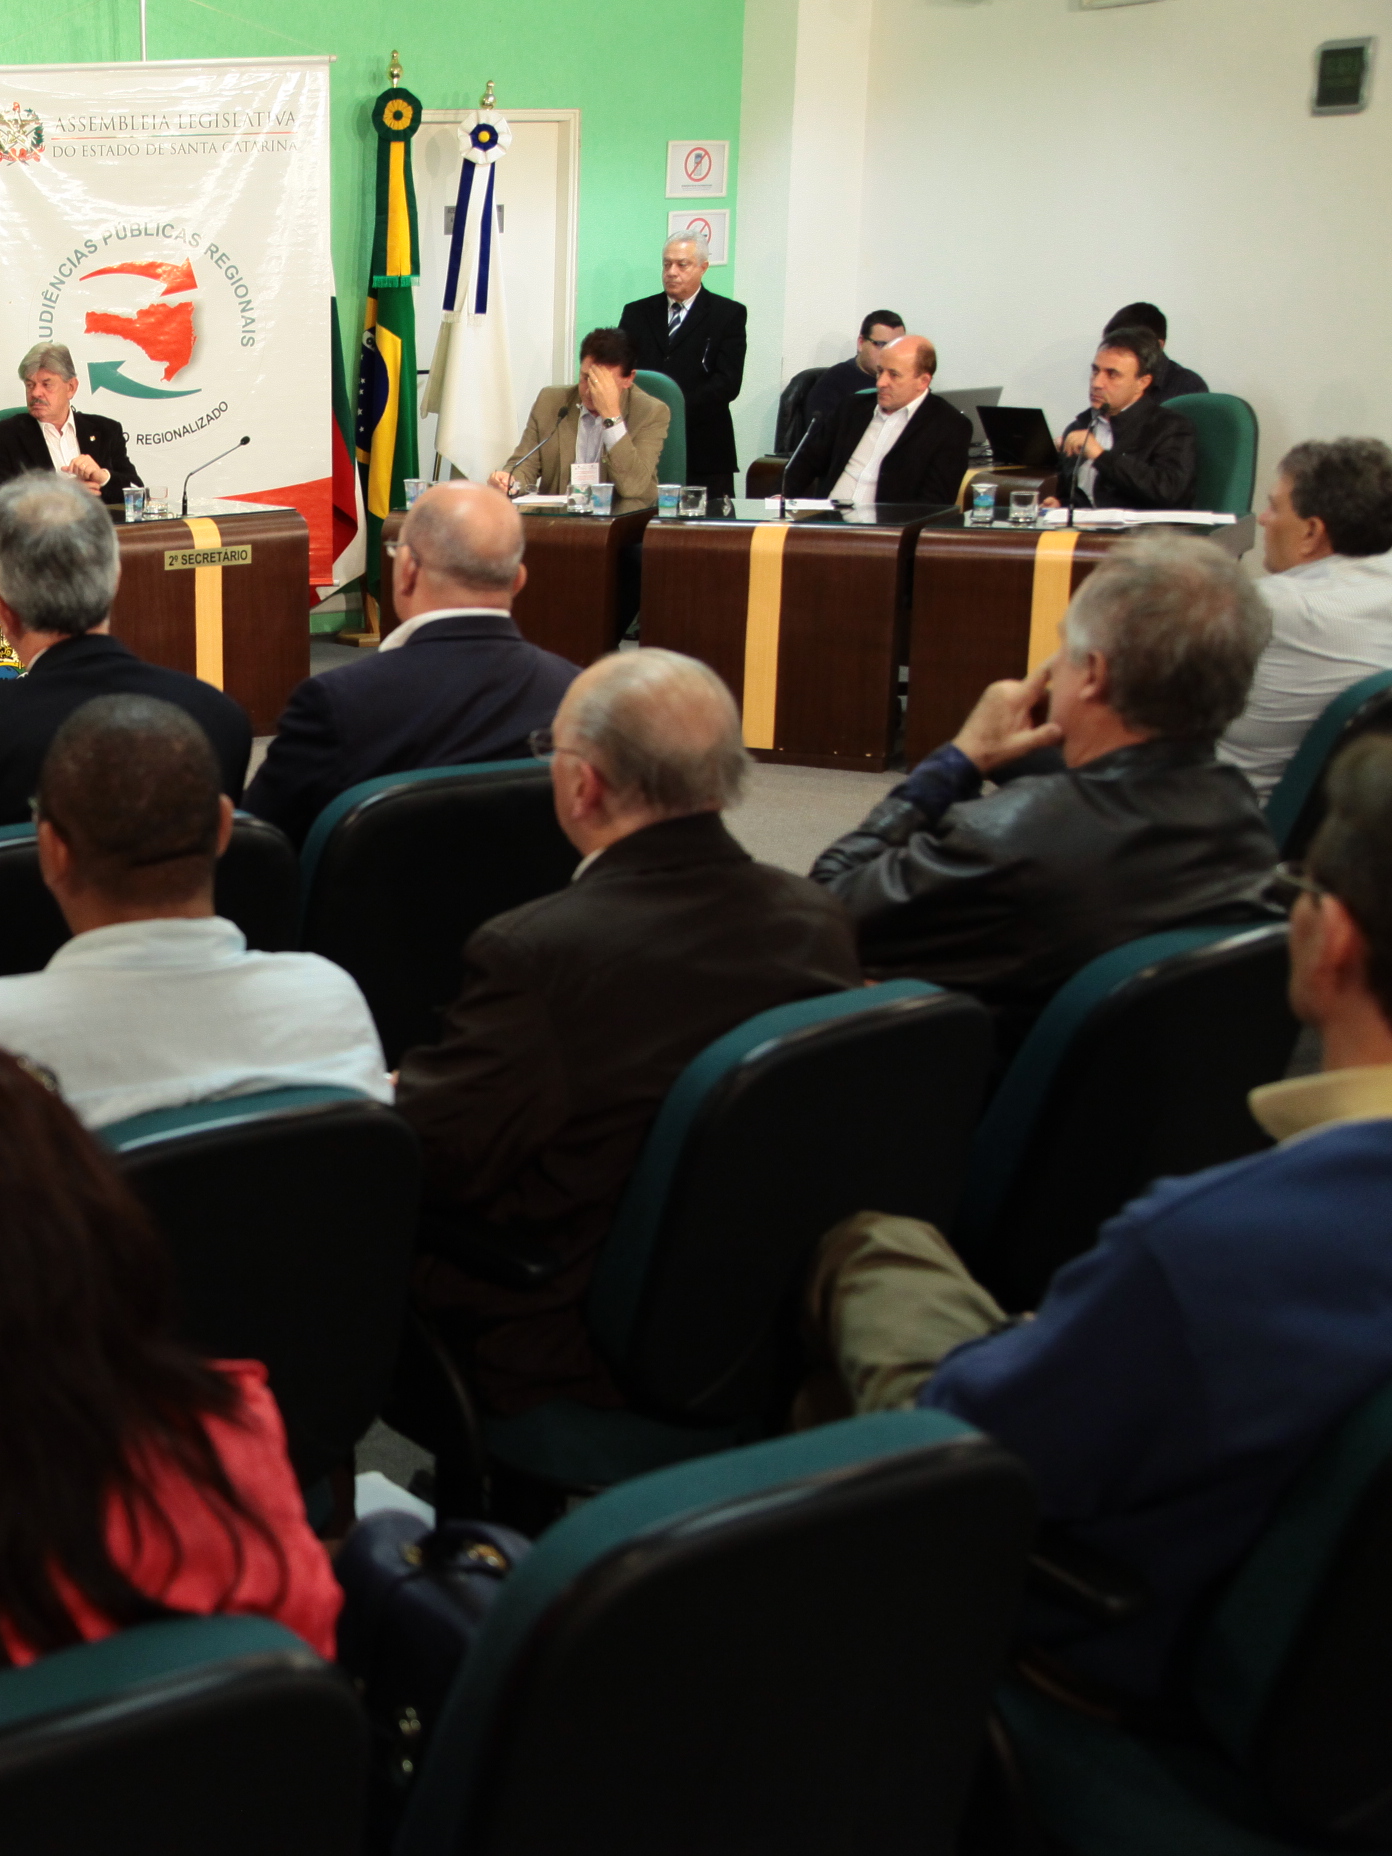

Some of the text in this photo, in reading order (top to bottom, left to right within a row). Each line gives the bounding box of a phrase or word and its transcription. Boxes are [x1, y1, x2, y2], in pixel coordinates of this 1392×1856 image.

[55, 111, 296, 132] ASSEMBLEIA LEGISLATIVA
[52, 145, 76, 158] DO
[82, 144, 140, 157] ESTADO
[146, 143, 164, 156] DE
[170, 141, 217, 155] SANTA
[222, 139, 298, 153] CATARINA
[38, 220, 256, 348] UDIÊNCIAS PÚBLICAS REGIONAIS
[136, 401, 229, 446] REGIONALIZADO
[181, 548, 248, 566] SECRETÁRIO
